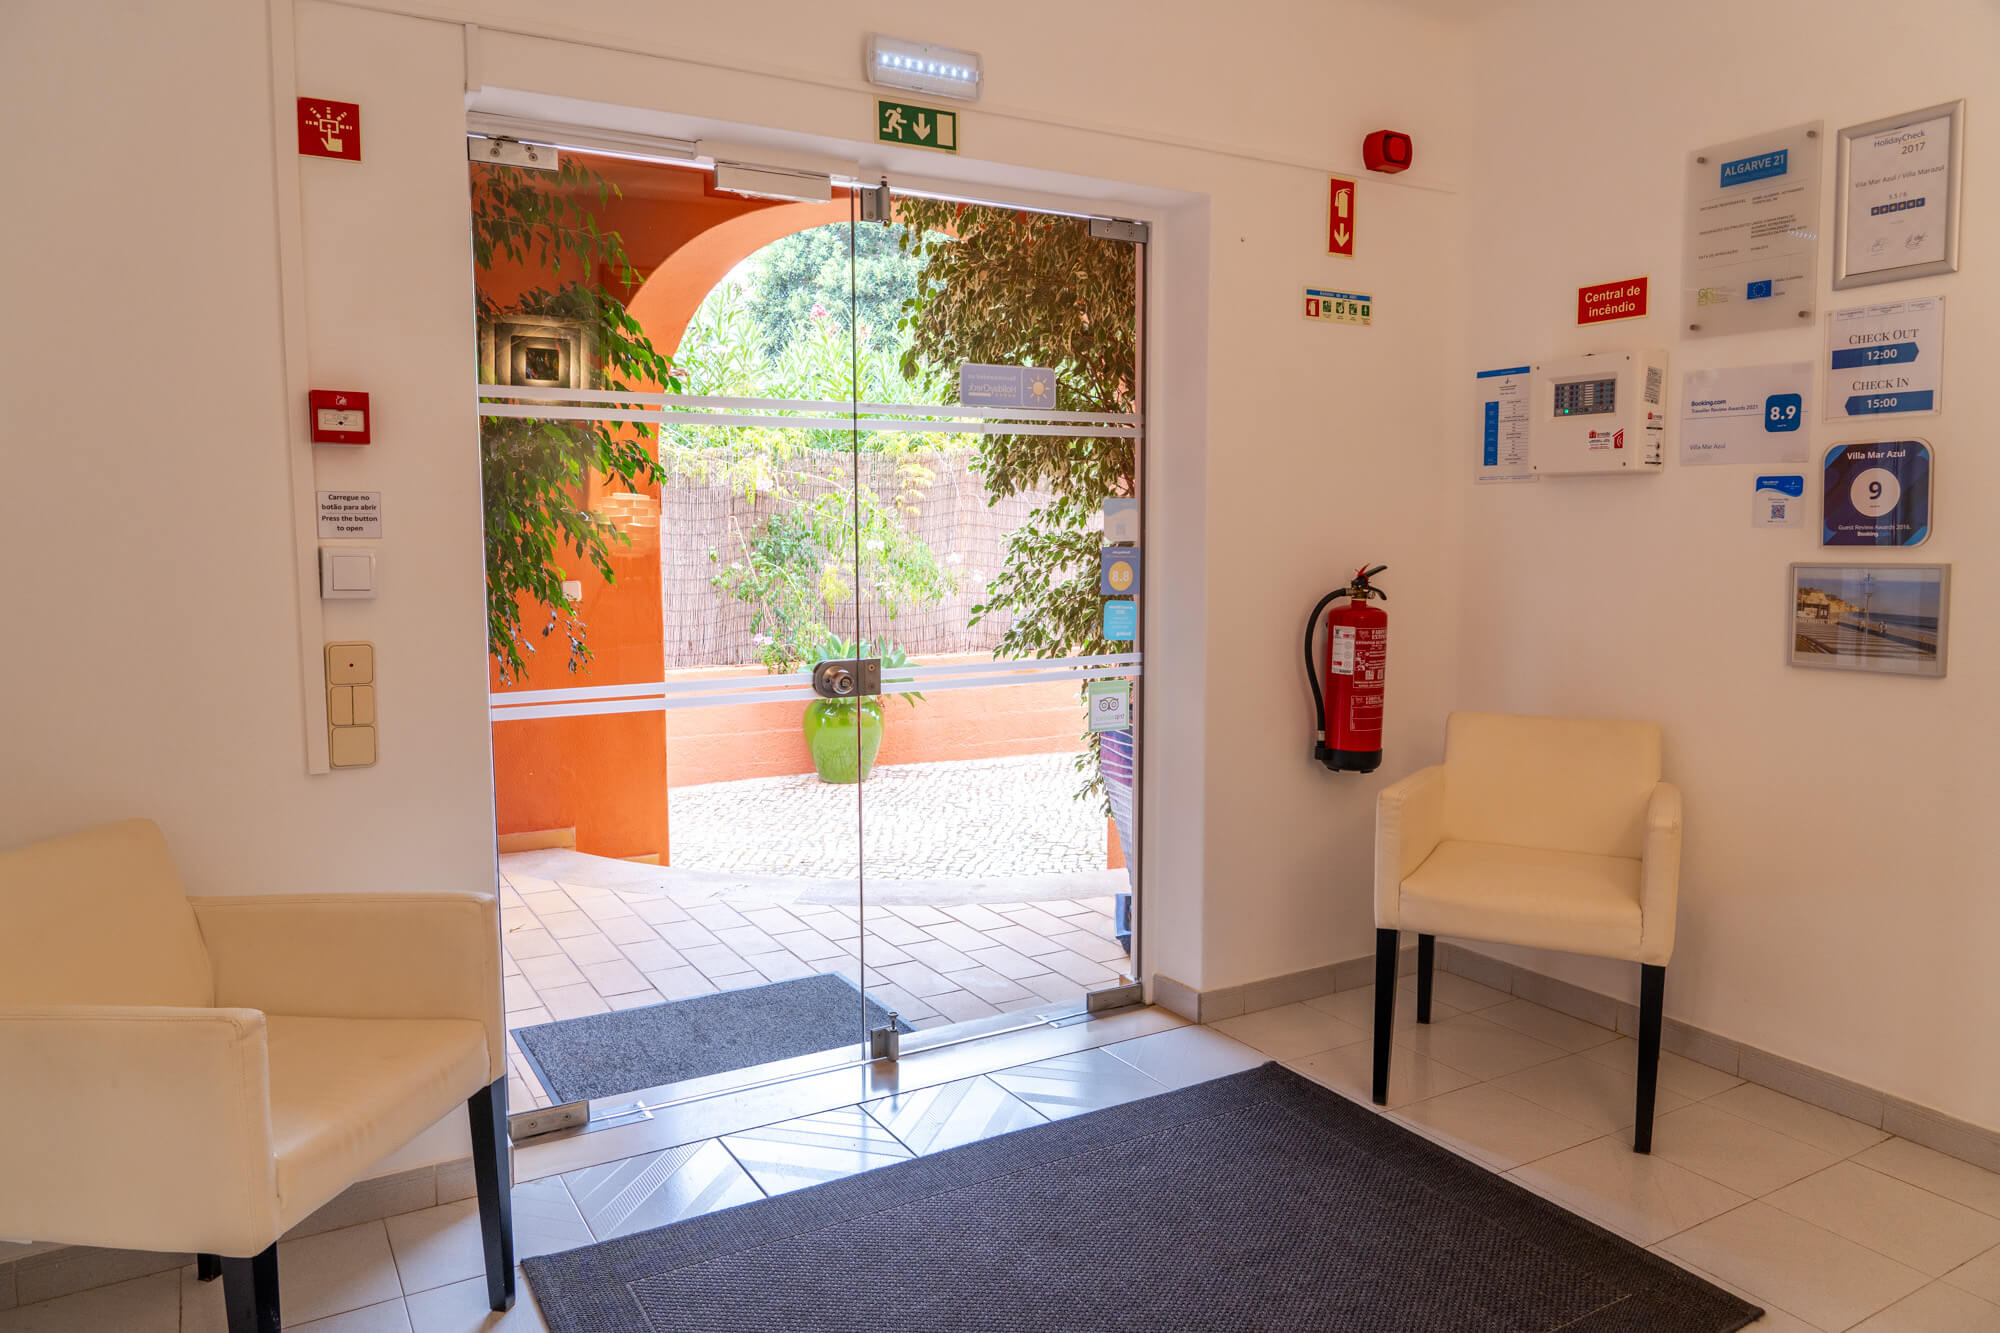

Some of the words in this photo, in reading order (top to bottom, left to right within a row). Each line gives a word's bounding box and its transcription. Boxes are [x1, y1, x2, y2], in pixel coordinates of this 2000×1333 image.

[1874, 130, 1925, 148] HolidayCheck
[1901, 142, 1926, 155] 2017
[1724, 157, 1771, 177] ALGARVE
[1773, 154, 1785, 166] 21
[1585, 287, 1624, 303] Central
[1627, 285, 1641, 297] de
[1588, 301, 1636, 318] incêndio
[1849, 332, 1890, 345] CHECK
[1893, 328, 1920, 340] OUT
[1867, 348, 1898, 361] 12:00
[1852, 380, 1893, 391] CHECK
[1896, 377, 1910, 388] IN
[1691, 399, 1727, 407] Booking.com
[1867, 397, 1898, 409] 15:00
[1769, 404, 1797, 421] 8.9
[1847, 451, 1866, 460] Villa
[1867, 450, 1885, 460] Mar
[1886, 449, 1906, 458] Azul
[1868, 481, 1882, 500] 9
[321, 503, 342, 511] botão
[360, 503, 377, 511] abrir
